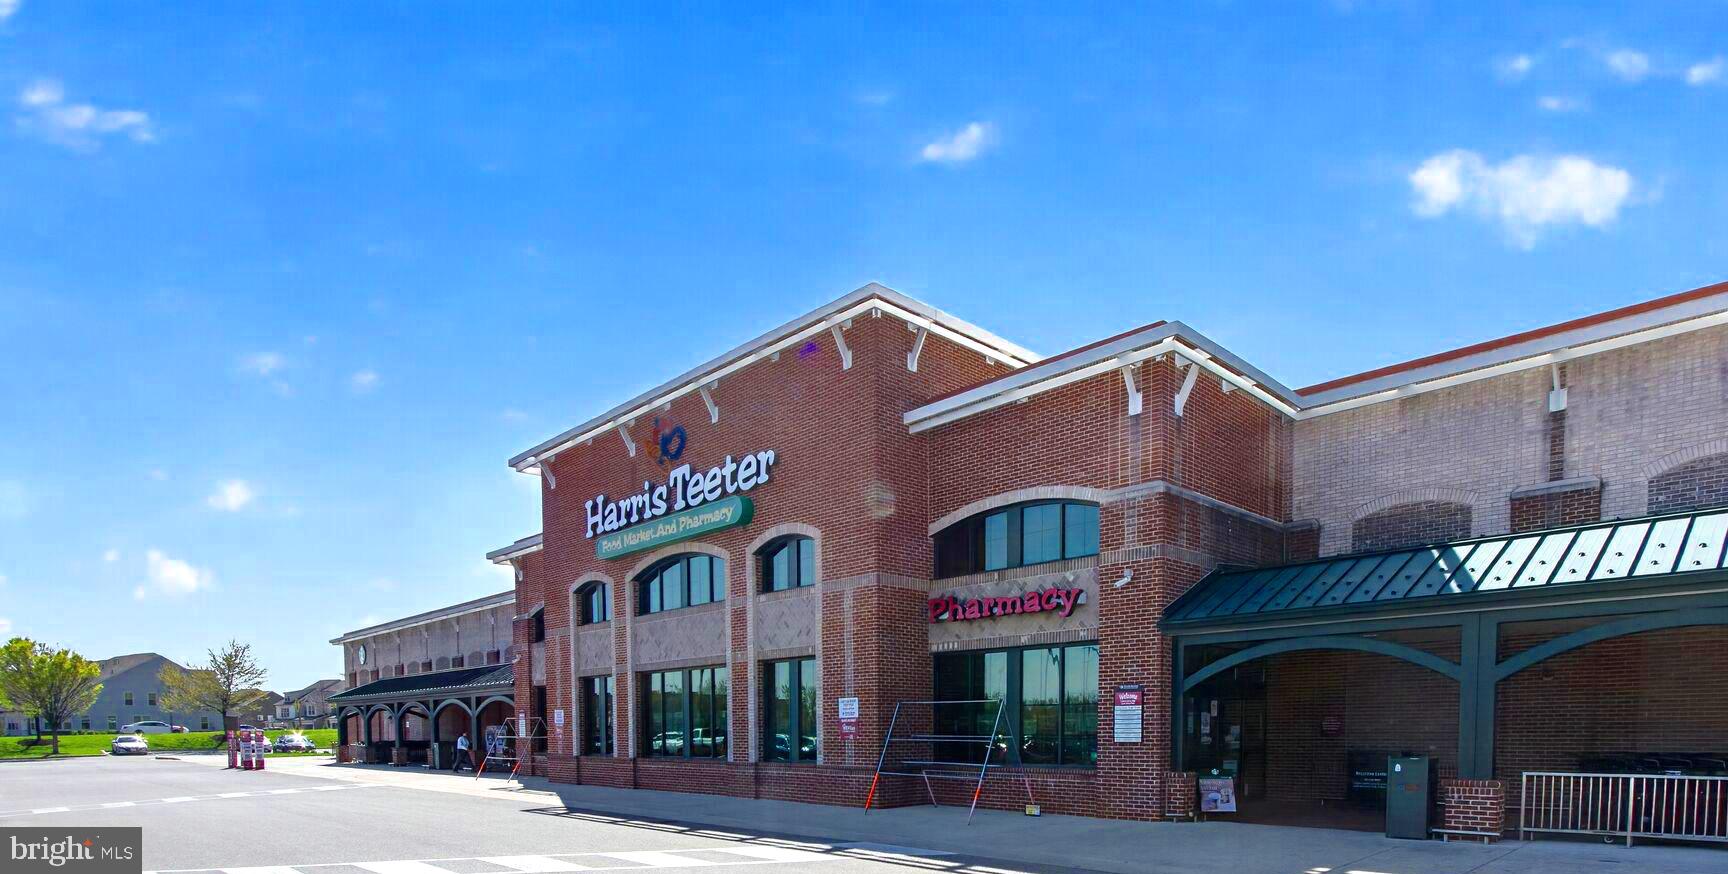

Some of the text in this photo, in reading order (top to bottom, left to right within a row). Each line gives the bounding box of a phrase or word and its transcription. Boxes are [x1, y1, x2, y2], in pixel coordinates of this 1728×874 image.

[585, 449, 775, 539] Harris Teeter
[602, 504, 736, 553] Food Market And Pharmacy
[928, 587, 1082, 624] Pharmacy
